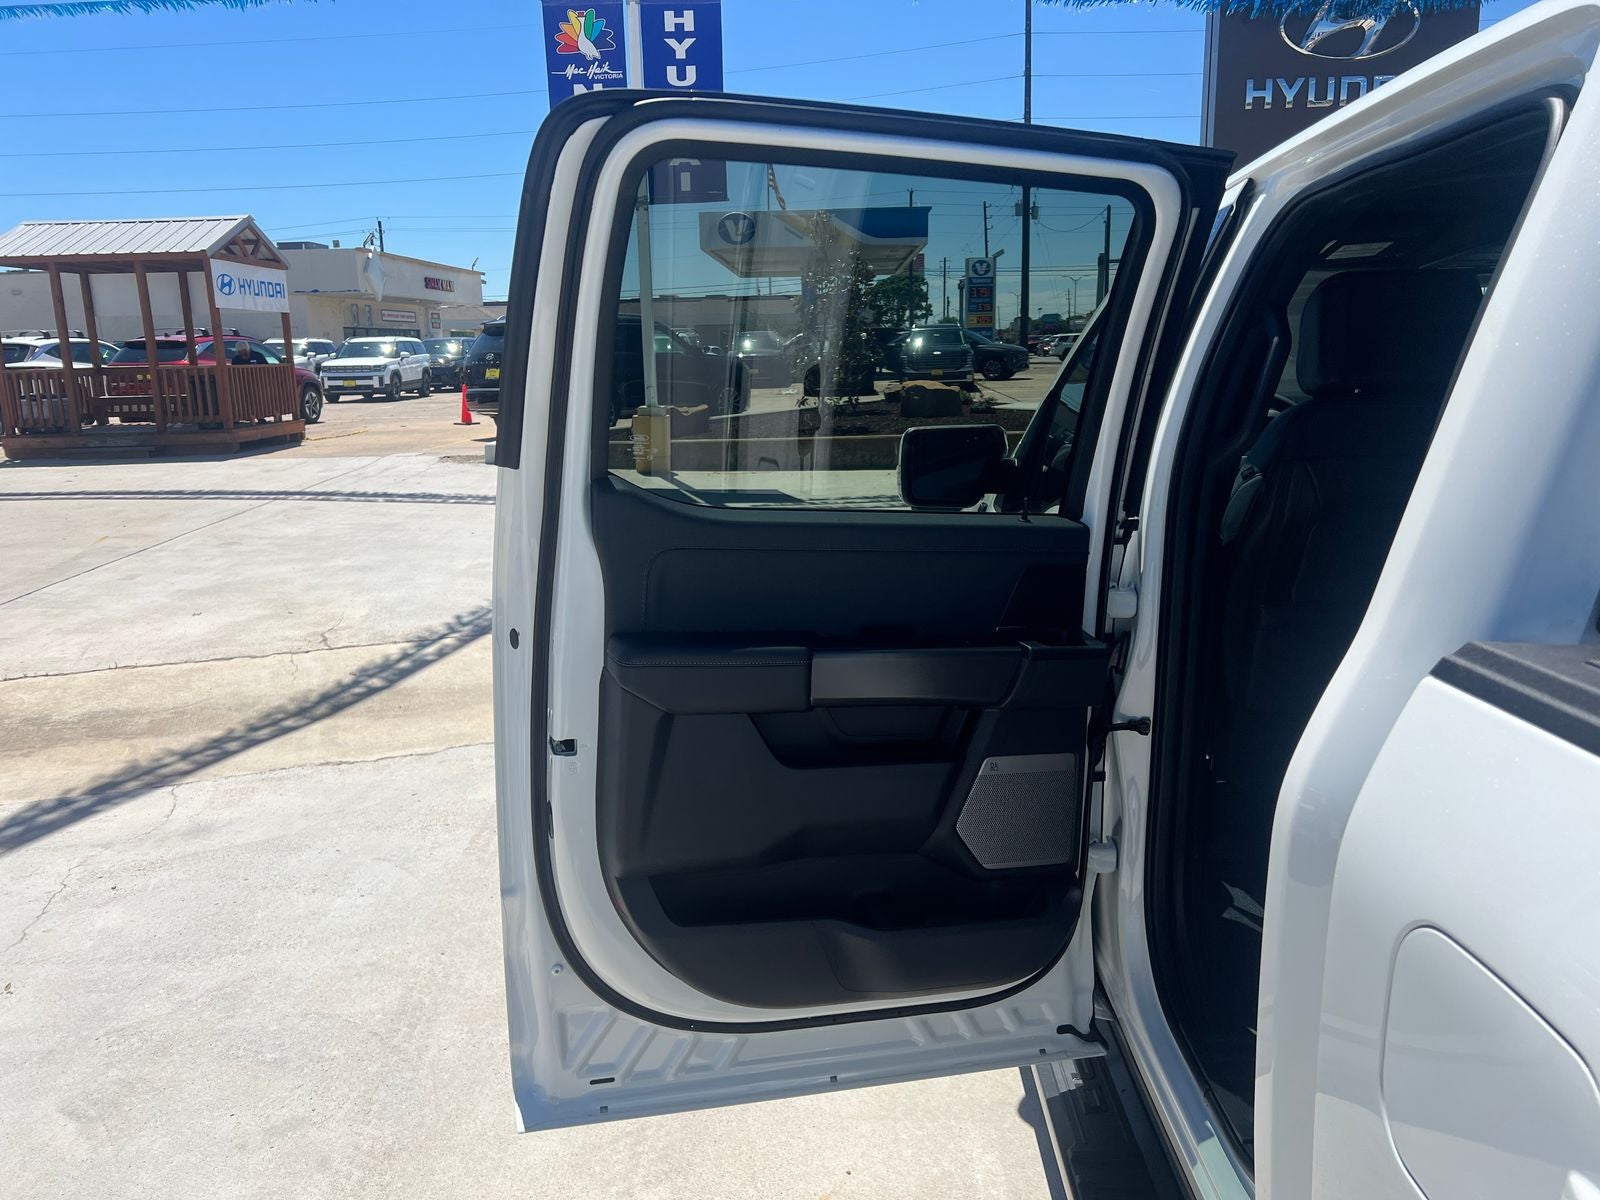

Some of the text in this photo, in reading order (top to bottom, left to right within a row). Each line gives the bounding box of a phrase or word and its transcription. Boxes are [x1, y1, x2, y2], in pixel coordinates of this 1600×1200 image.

[560, 61, 617, 80] Mac Haik
[1244, 75, 1396, 110] HYUN
[238, 277, 286, 299] HYUNDAI
